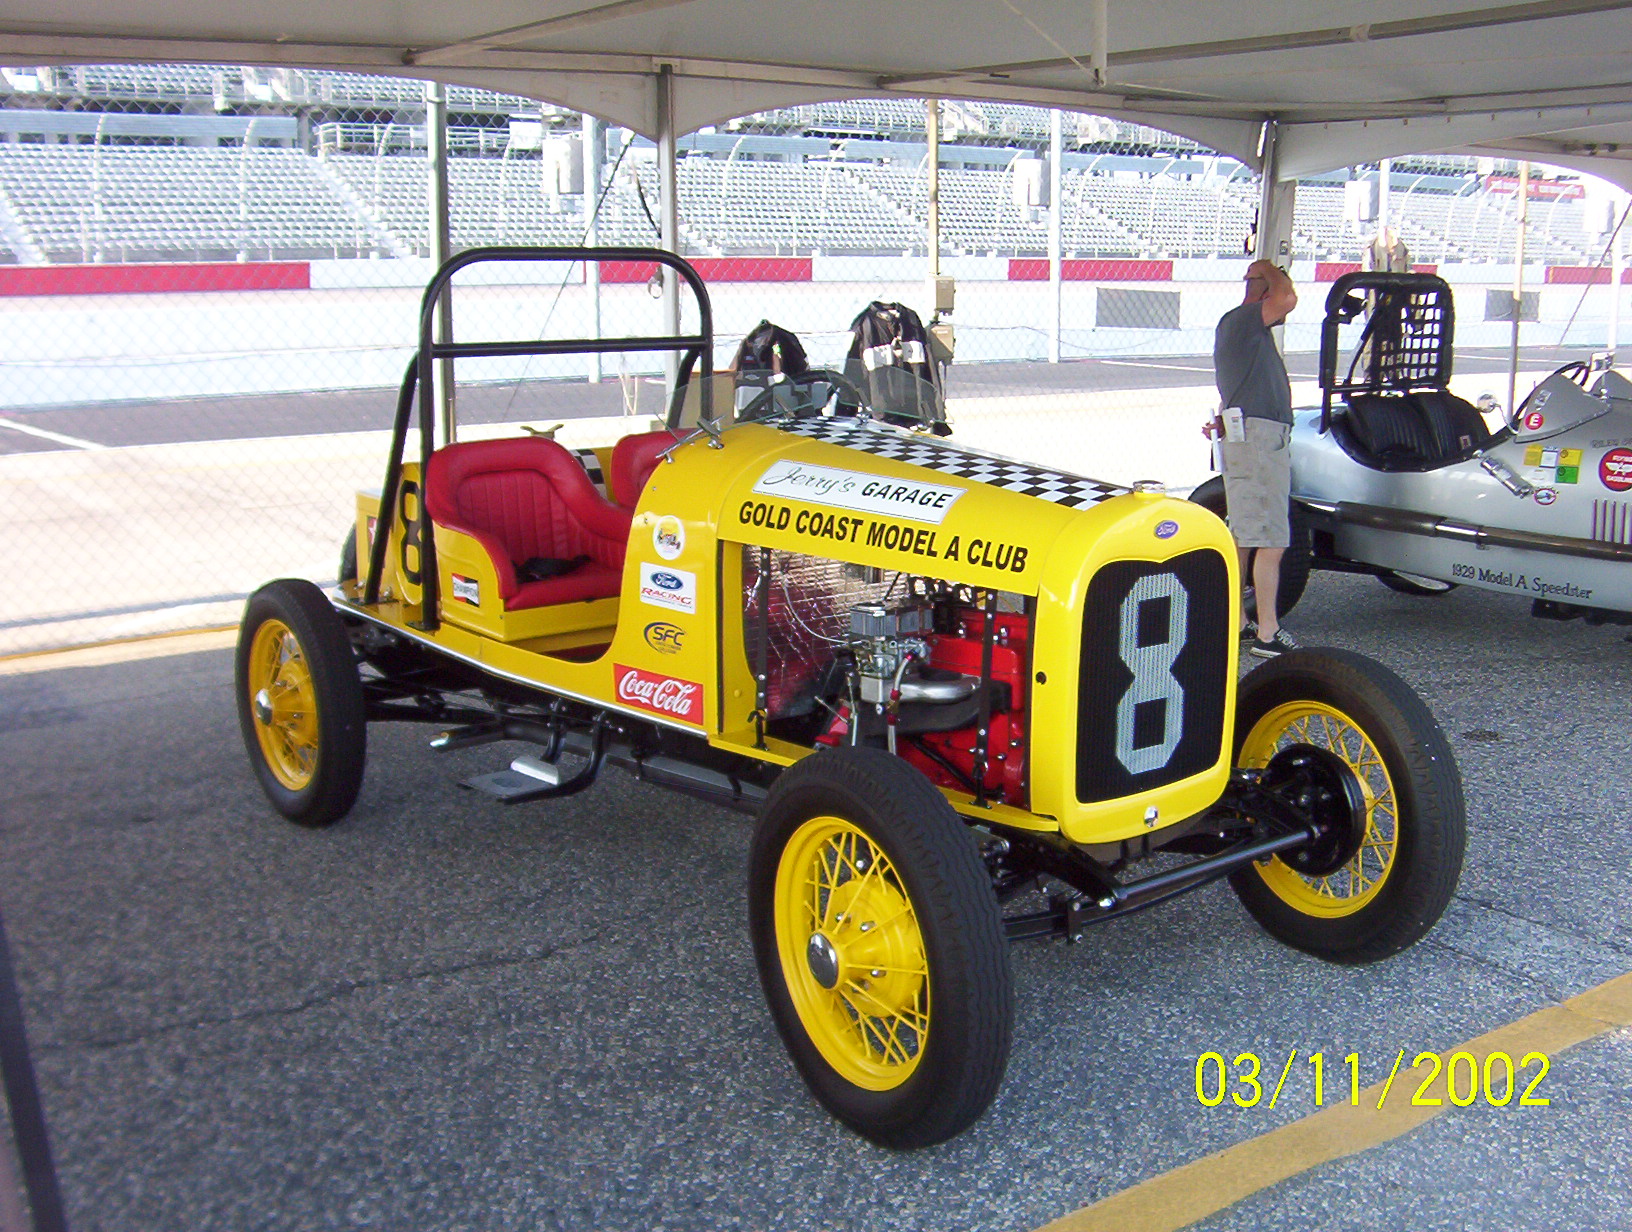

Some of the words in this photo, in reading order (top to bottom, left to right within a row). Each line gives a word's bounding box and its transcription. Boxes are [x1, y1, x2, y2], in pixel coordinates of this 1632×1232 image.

[1529, 414, 1540, 427] E
[763, 466, 856, 497] Jerry's
[861, 481, 954, 509] GARAGE
[399, 479, 423, 586] 8
[738, 500, 792, 532] GOLD
[795, 509, 864, 544] COAST
[865, 520, 940, 558] MODEL
[944, 535, 962, 562] A
[966, 538, 1030, 574] CLUB
[641, 587, 692, 605] RACING
[655, 573, 679, 588] Ford
[1452, 563, 1476, 580] 1929
[1478, 567, 1513, 588] Model
[1515, 574, 1529, 590] A
[1532, 577, 1593, 599] Speedster
[653, 626, 685, 647] SFC
[618, 670, 697, 716] Coca-Cola
[1116, 573, 1187, 775] 8
